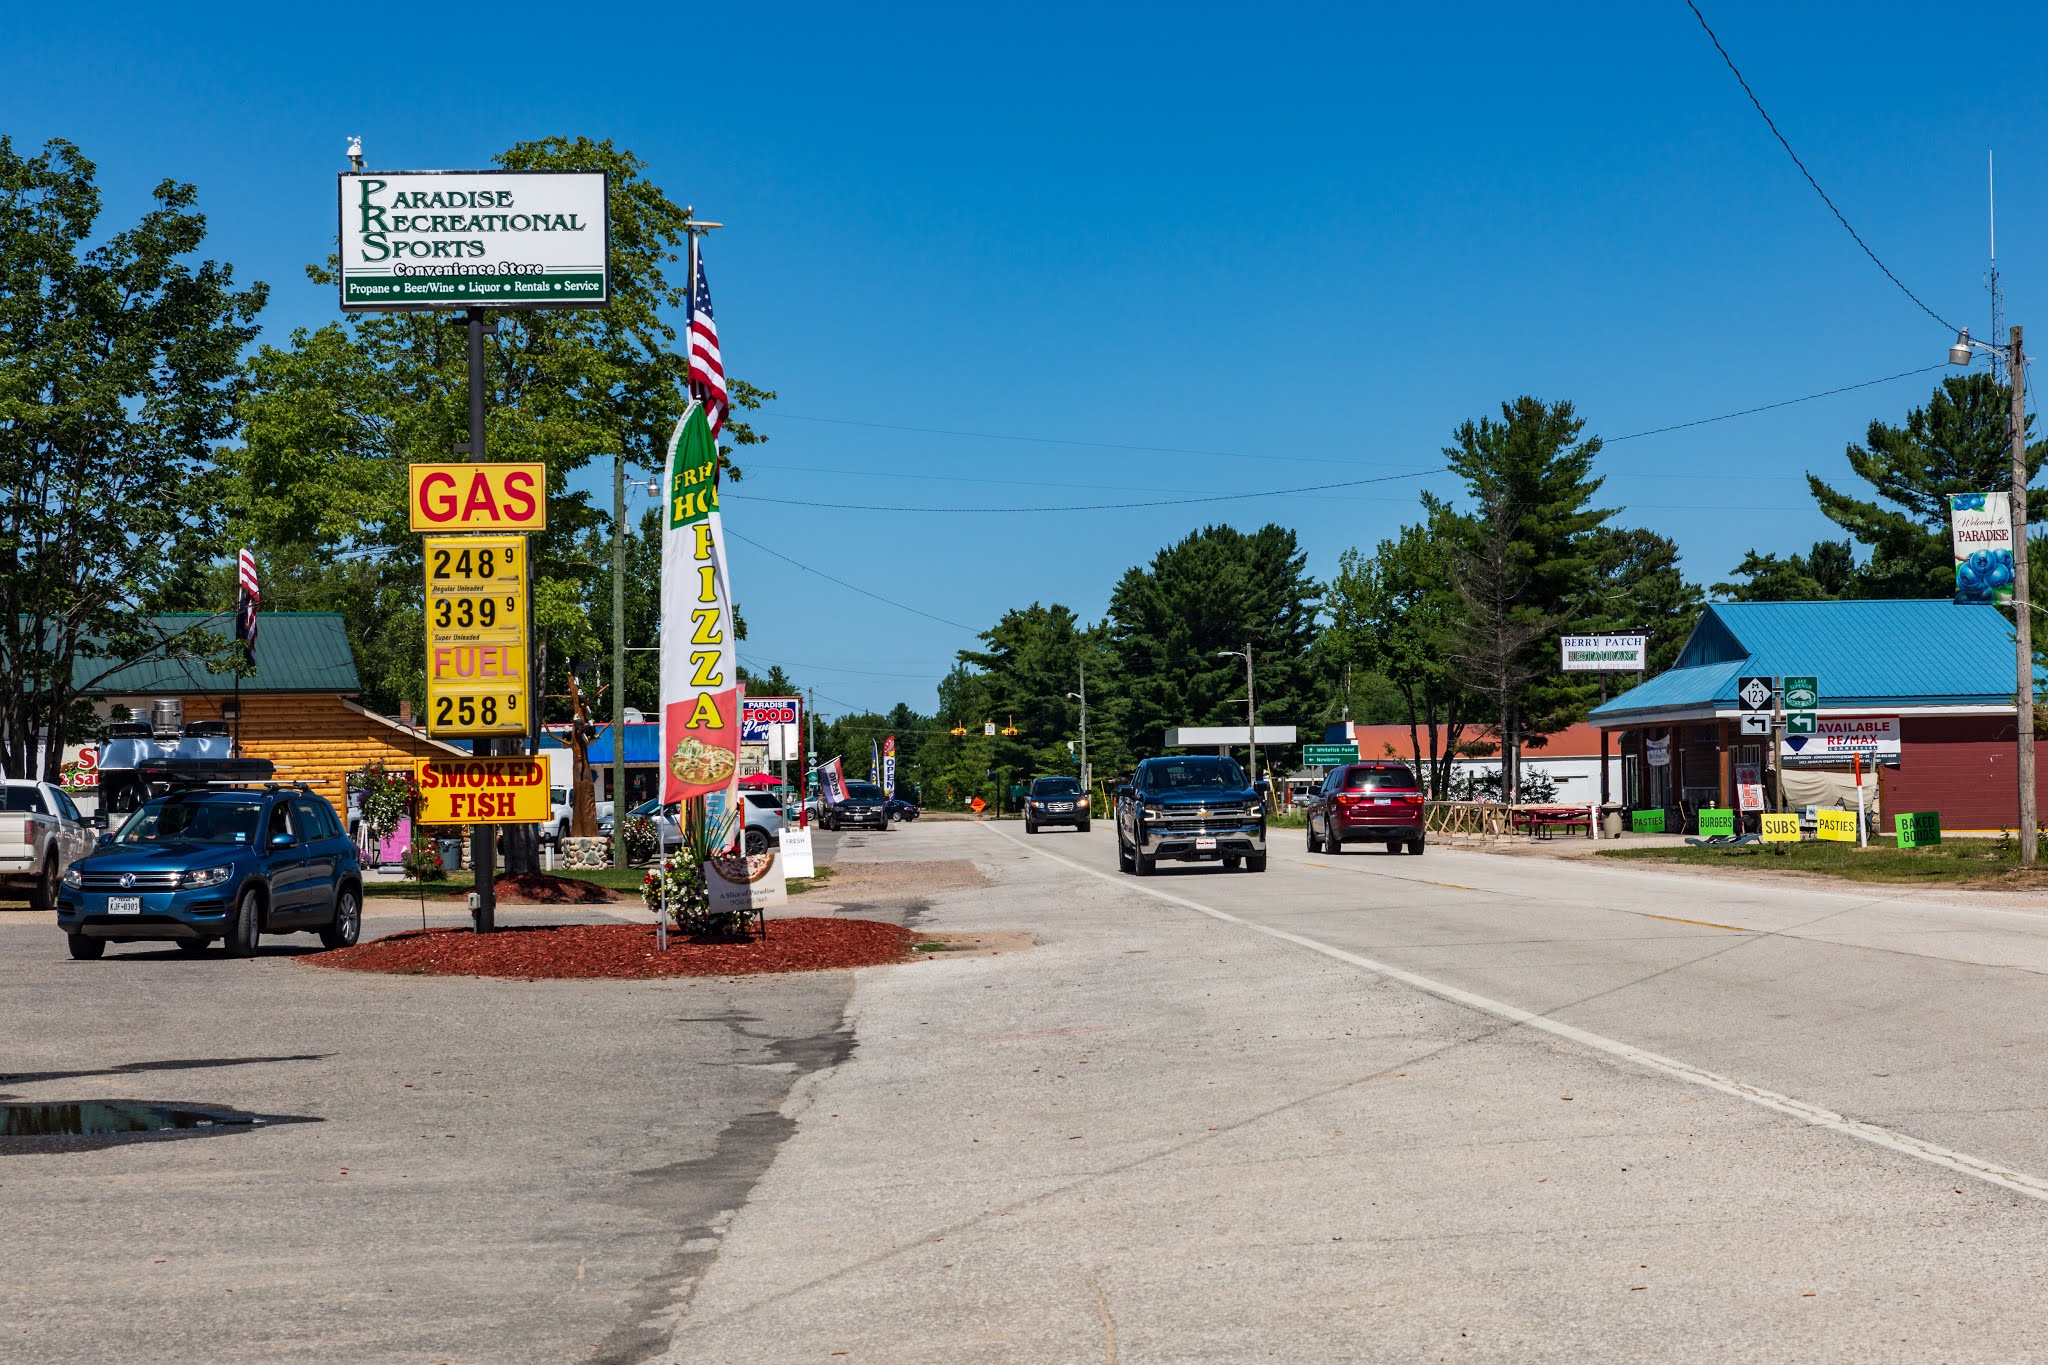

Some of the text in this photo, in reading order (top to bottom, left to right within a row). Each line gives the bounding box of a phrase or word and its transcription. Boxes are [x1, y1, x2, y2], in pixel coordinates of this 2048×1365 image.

[358, 179, 514, 209] PARADISE
[359, 205, 586, 234] RECREATIONAL
[361, 231, 486, 263] SPORTS
[393, 261, 543, 278] Convenience Store
[350, 280, 599, 296] Propane Beer/Wine Liquor Rentals Service
[419, 471, 536, 522] GAS
[1958, 516, 2005, 527] Welcome to
[1958, 529, 2009, 542] PARADISE
[434, 548, 514, 579] 248 9
[435, 597, 515, 628] 339 9
[685, 523, 725, 730] PIZZA
[1564, 637, 1642, 647] BERRY PATCH
[435, 647, 518, 677] FUEL
[1568, 650, 1639, 662] RESTAURANT
[1748, 690, 1764, 703] 123
[436, 694, 516, 726] 258 9
[743, 708, 795, 723] FOOD
[1817, 721, 1890, 733] AVAILABLE
[1827, 735, 1877, 746] RE/MAX
[421, 761, 543, 789] SMOKED
[887, 759, 895, 789] OPEN
[829, 771, 841, 797] OPEN
[450, 792, 515, 818] FISH
[1634, 816, 1663, 827] PASTIES
[1700, 816, 1733, 828] BURGERS
[1765, 820, 1797, 834] SUBS
[1819, 819, 1854, 832] PASTIES
[1901, 816, 1934, 830] BAKED
[1903, 829, 1935, 843] GOODS
[750, 888, 776, 896] Paradise
